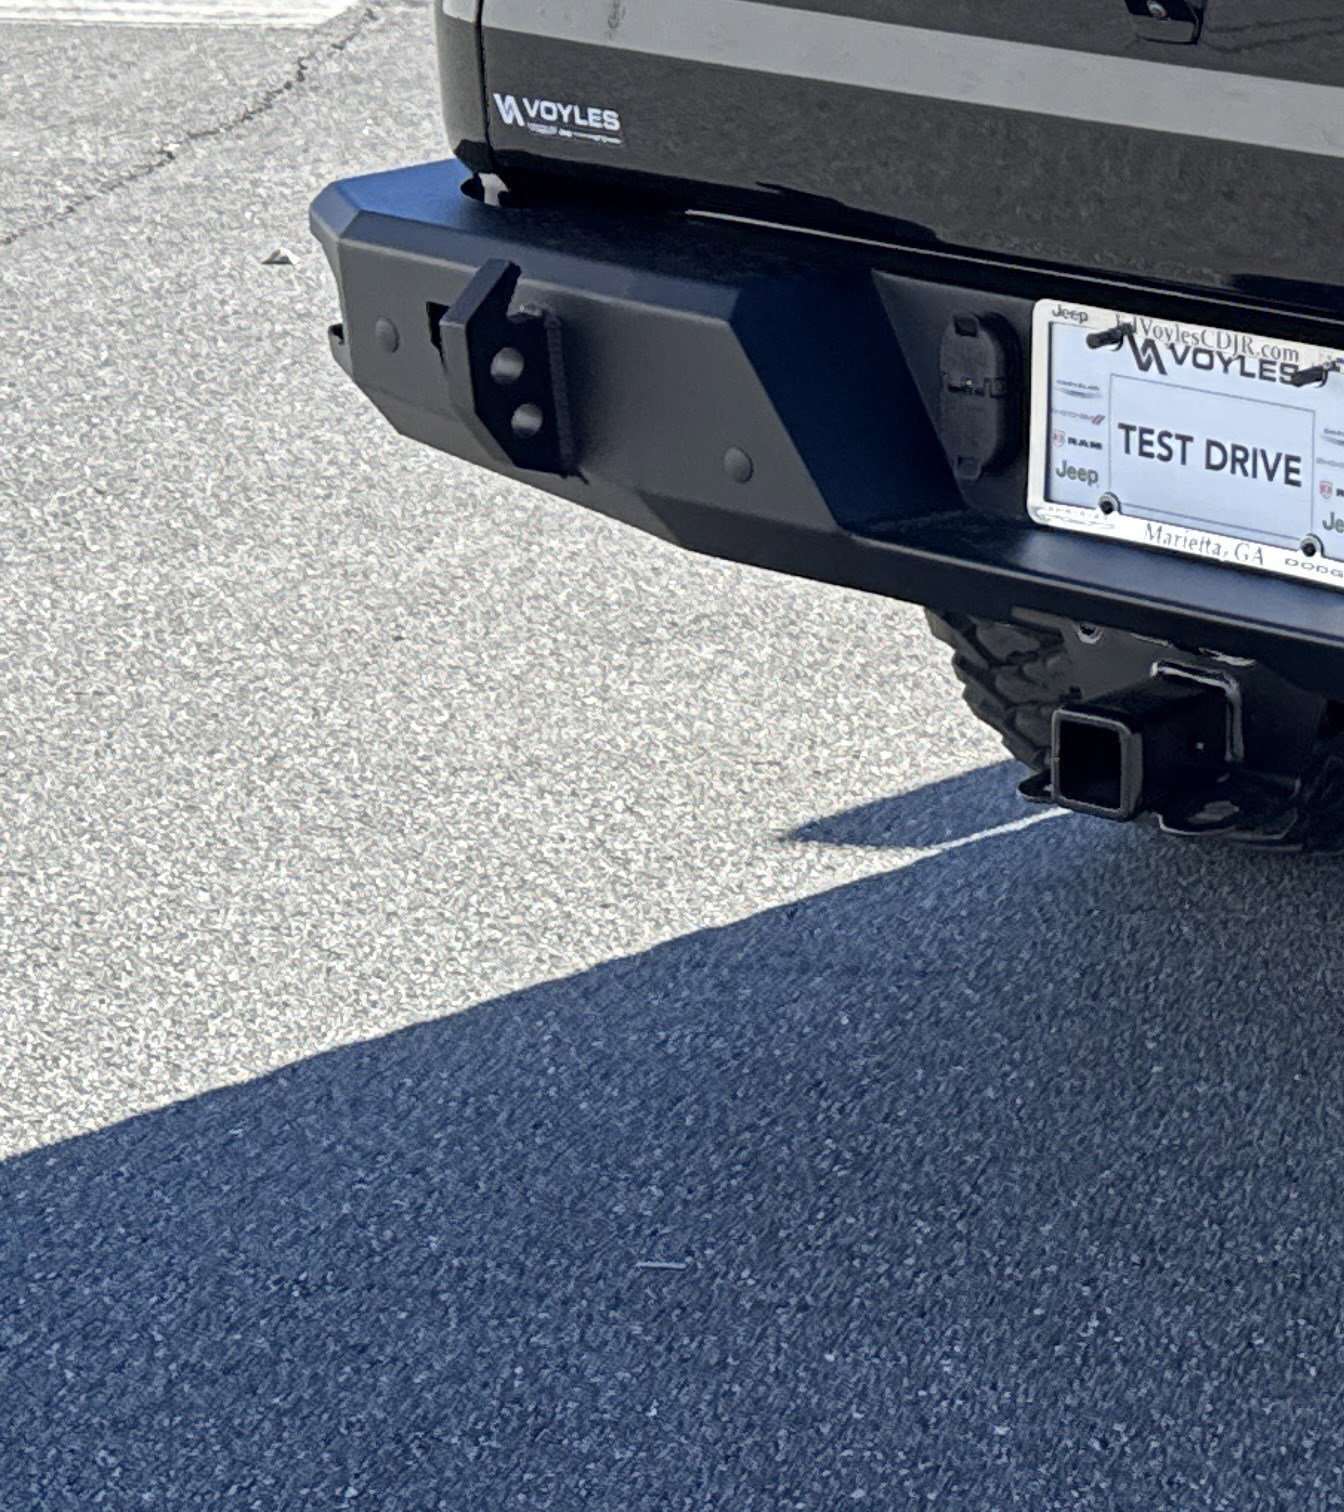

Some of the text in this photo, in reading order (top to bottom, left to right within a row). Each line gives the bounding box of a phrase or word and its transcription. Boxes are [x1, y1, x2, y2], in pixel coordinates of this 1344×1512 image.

[522, 97, 620, 131] VOYLES
[1052, 304, 1089, 323] Jeep
[1168, 342, 1300, 387] VOYLES
[1067, 436, 1103, 450] RAM
[1117, 422, 1303, 488] TEST DRIVE
[1055, 460, 1099, 486] Jeep
[1144, 522, 1265, 566] Marietta, GA
